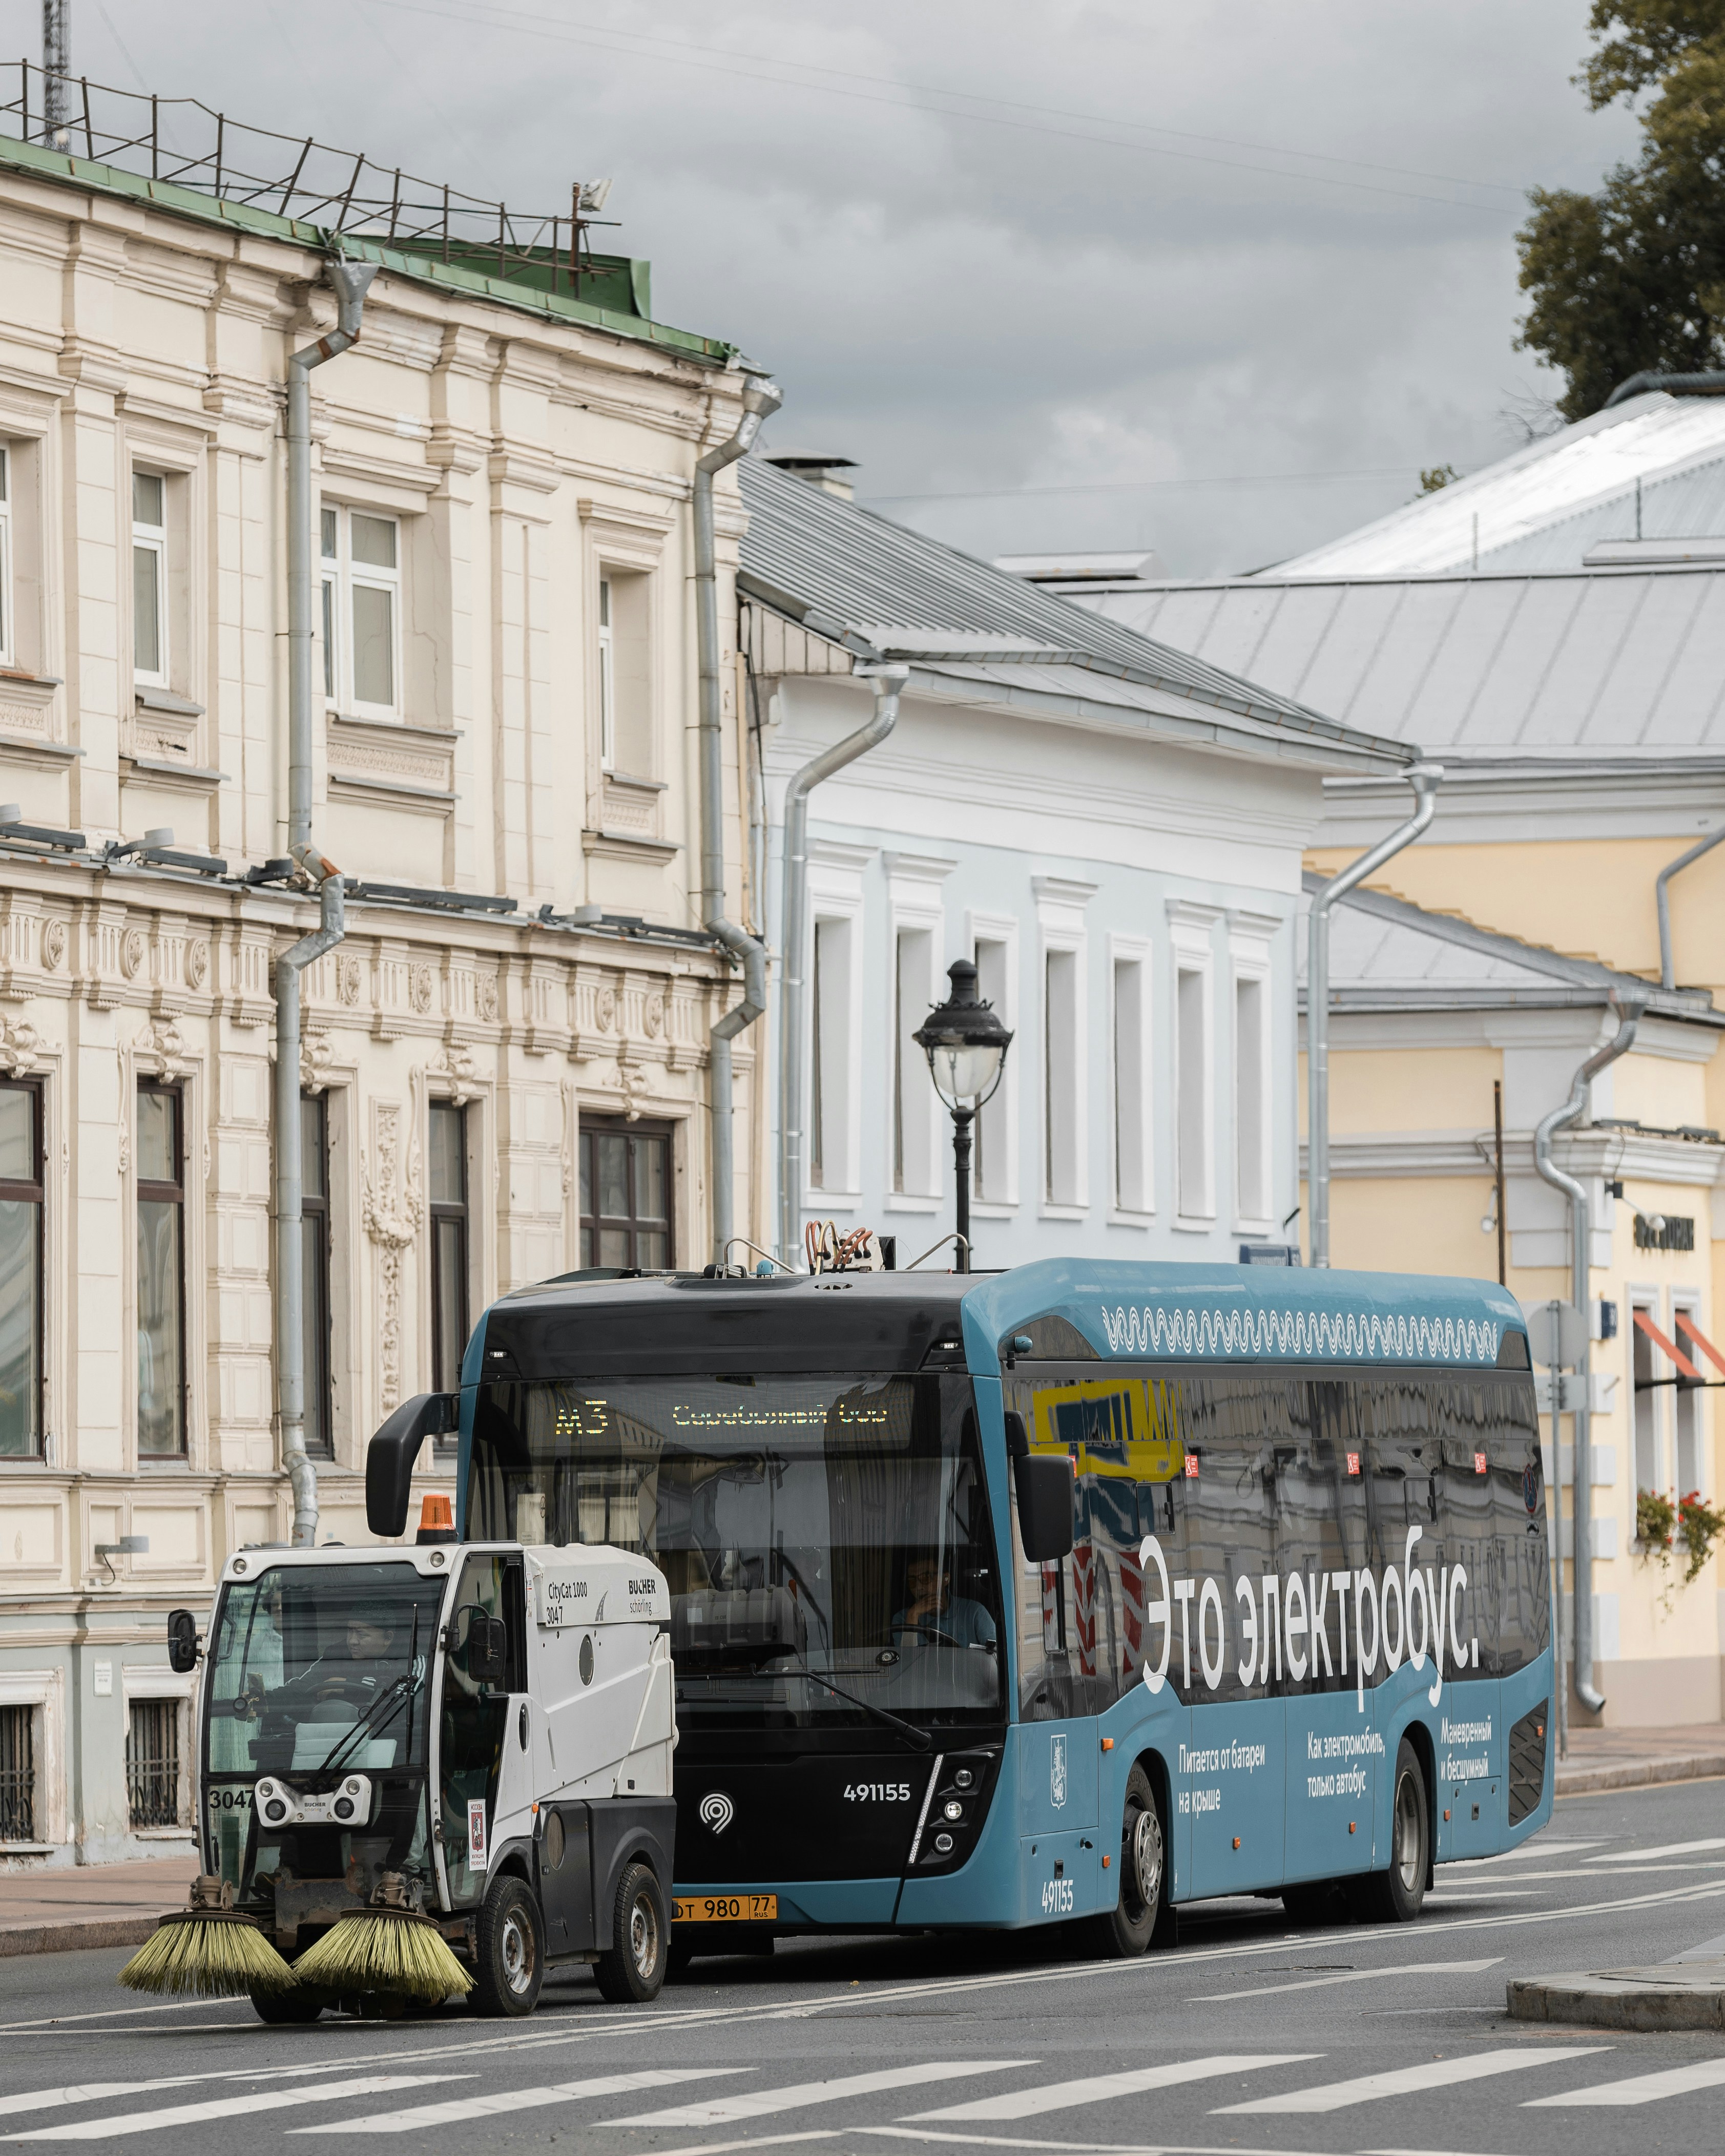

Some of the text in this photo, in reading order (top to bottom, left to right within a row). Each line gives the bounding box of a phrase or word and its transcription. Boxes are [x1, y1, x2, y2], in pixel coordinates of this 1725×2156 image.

[548, 1581, 587, 1603] CityCat 1000
[628, 1579, 656, 1595] BUCHER
[547, 1606, 563, 1624] 3047
[1138, 1525, 1479, 1712] Это электробус.
[1307, 1725, 1385, 1763] Как электромобиль,
[1441, 1714, 1492, 1749] Маневренный
[1179, 1739, 1265, 1774] Питается от батареи
[1441, 1751, 1489, 1786] и бесшумный
[844, 1784, 910, 1801] 491155
[1307, 1763, 1366, 1798] только автобус
[209, 1790, 255, 1809] 3047
[1179, 1788, 1221, 1818] на крыше
[704, 1899, 740, 1918] 980
[752, 1897, 770, 1911] 77
[1042, 1879, 1073, 1913] 491155
